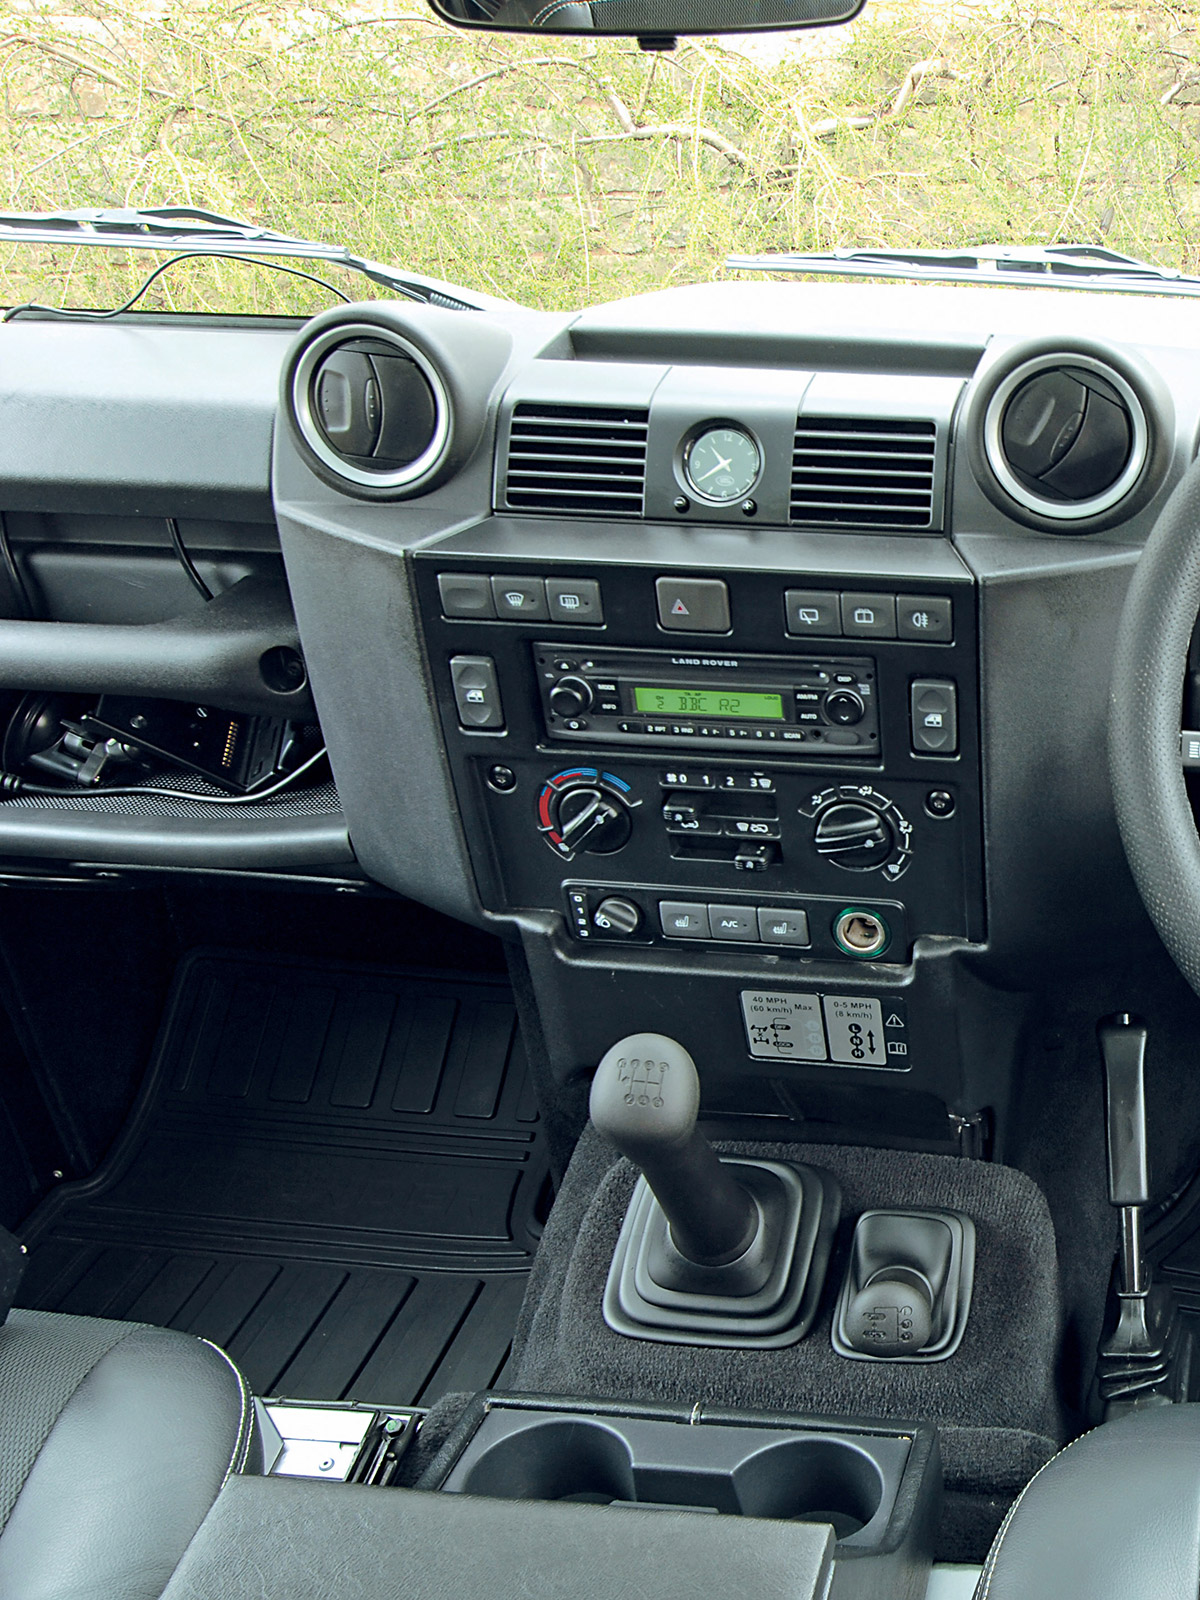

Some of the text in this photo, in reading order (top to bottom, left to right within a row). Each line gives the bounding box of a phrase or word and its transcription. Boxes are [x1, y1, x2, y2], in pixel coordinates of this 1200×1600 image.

[671, 658, 738, 667] LAND ROVER
[678, 696, 708, 712] BBC
[719, 698, 741, 713] R2
[674, 726, 680, 734] 3
[680, 774, 709, 784] 0 1
[726, 776, 758, 788] 2 3
[721, 920, 738, 928] A/C
[767, 1006, 792, 1014] km/h)
[850, 1002, 872, 1010] MPH
[846, 1012, 872, 1020] km/h)
